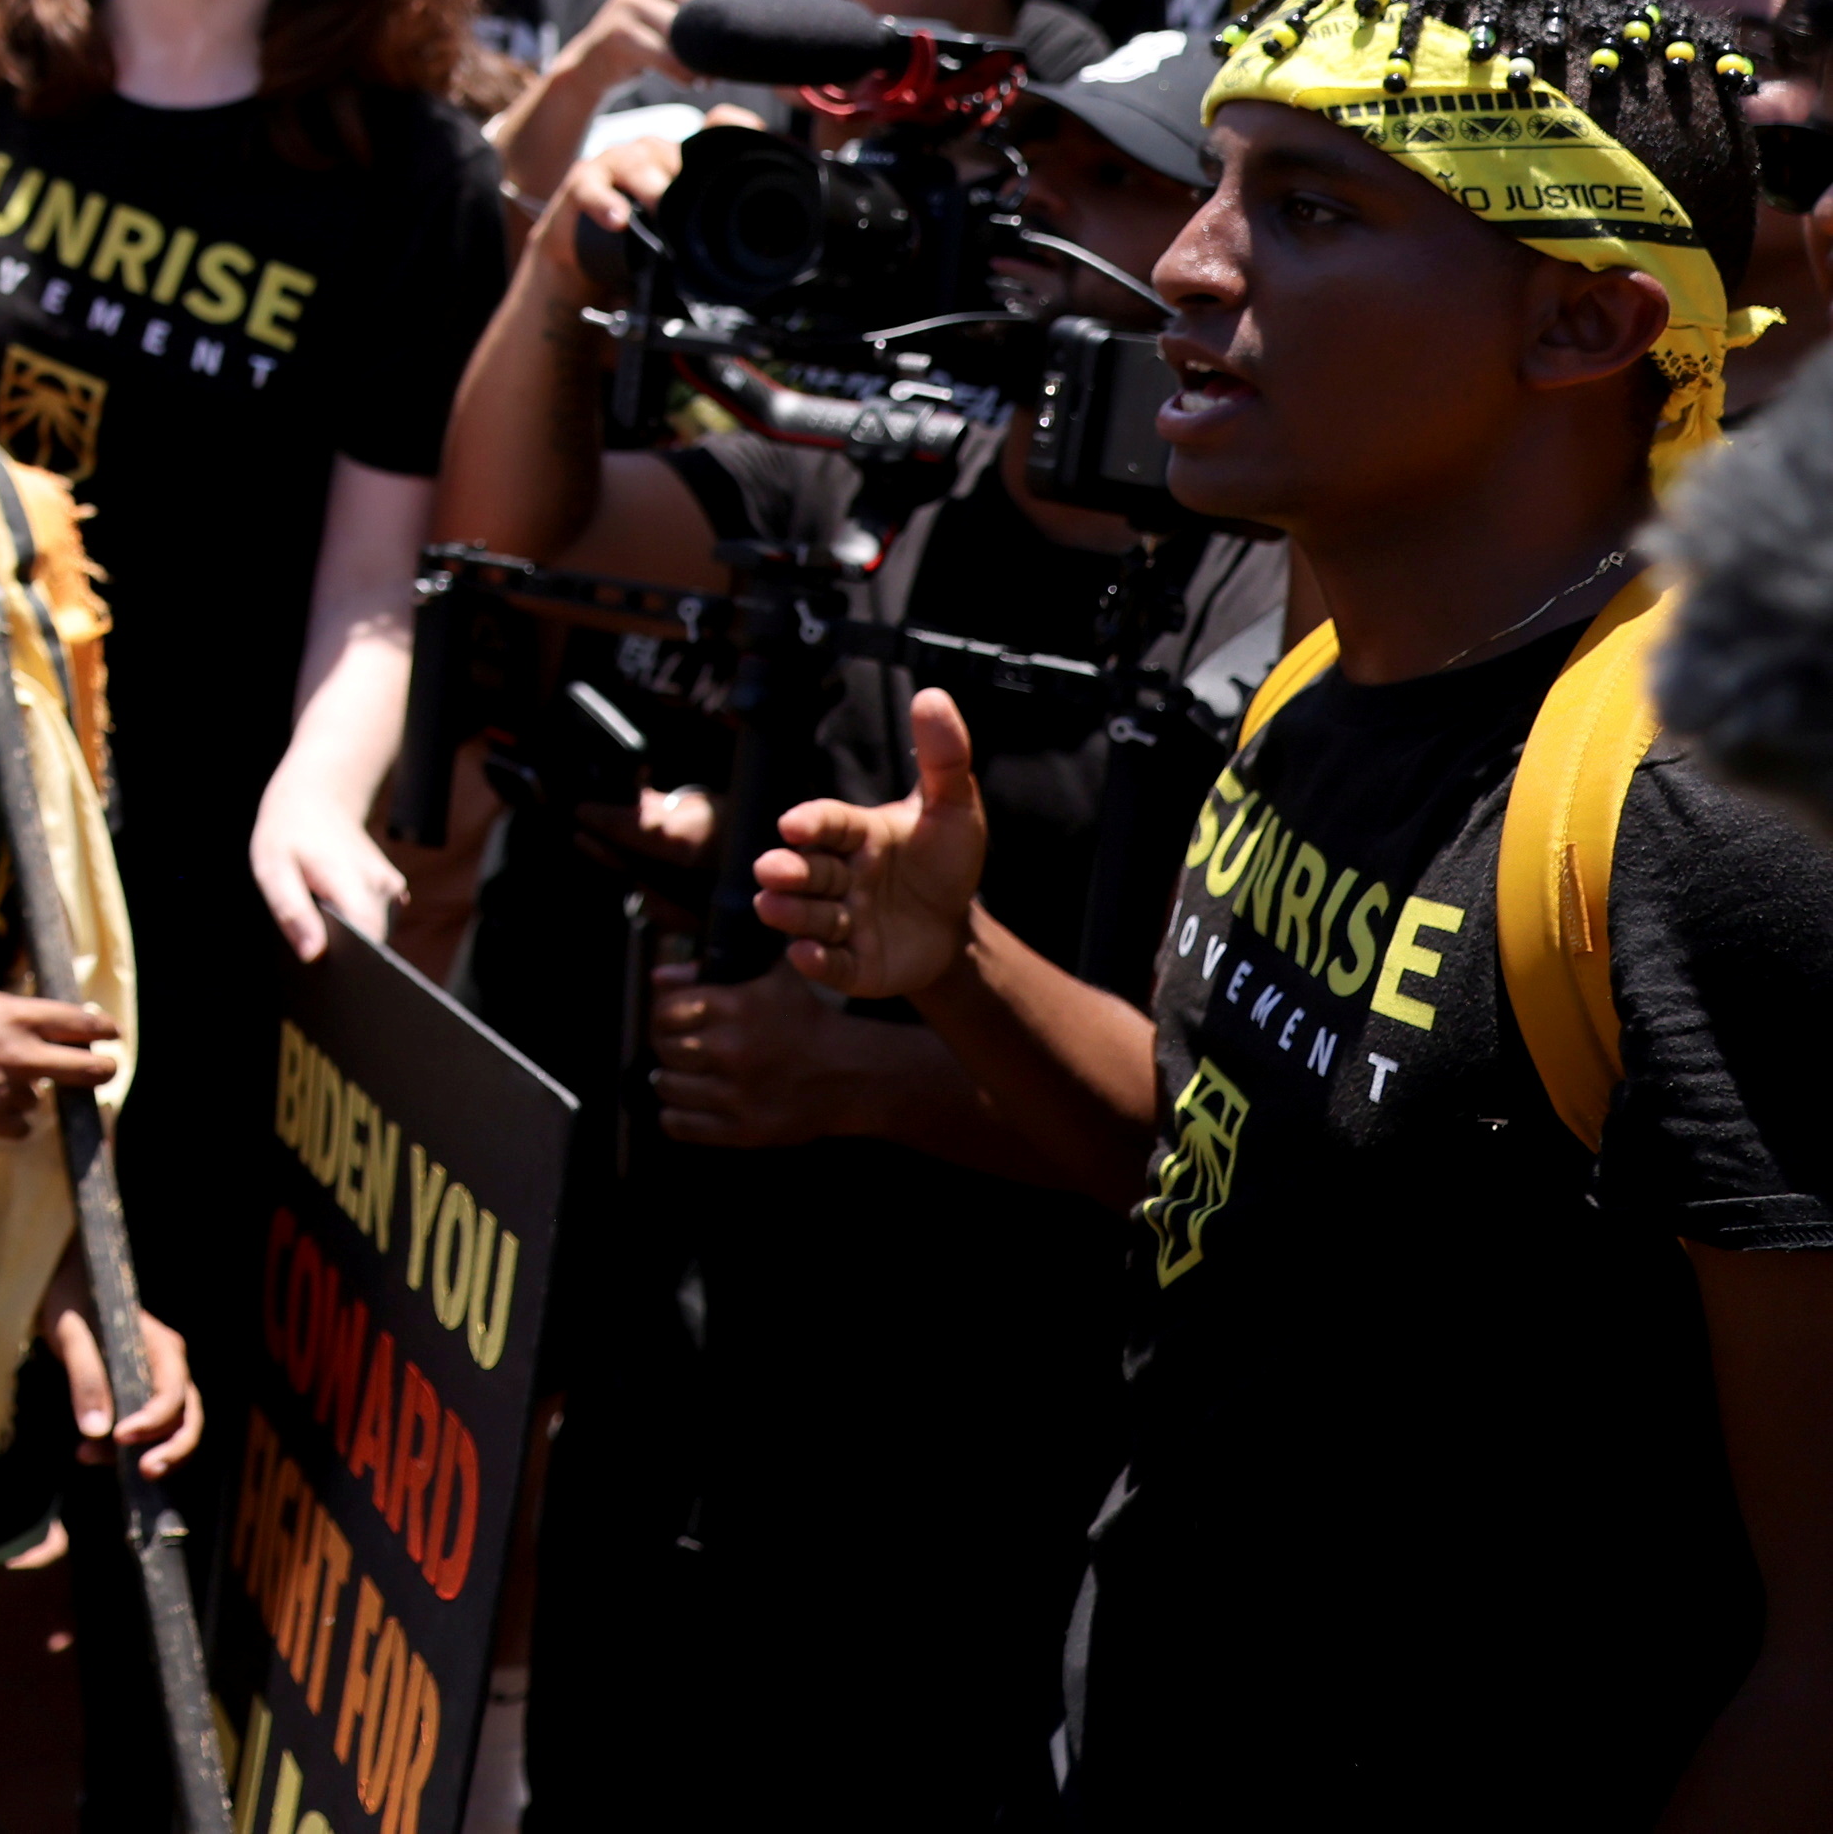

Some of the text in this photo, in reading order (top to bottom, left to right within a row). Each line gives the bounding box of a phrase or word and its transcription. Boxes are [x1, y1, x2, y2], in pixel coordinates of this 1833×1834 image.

[1505, 184, 1645, 212] JUSTICE
[1185, 766, 1466, 1032] SUNRISE
[277, 1020, 519, 1369] BIDEN YOU
[265, 1206, 479, 1600] COWARD
[335, 1576, 441, 1834] FOR
